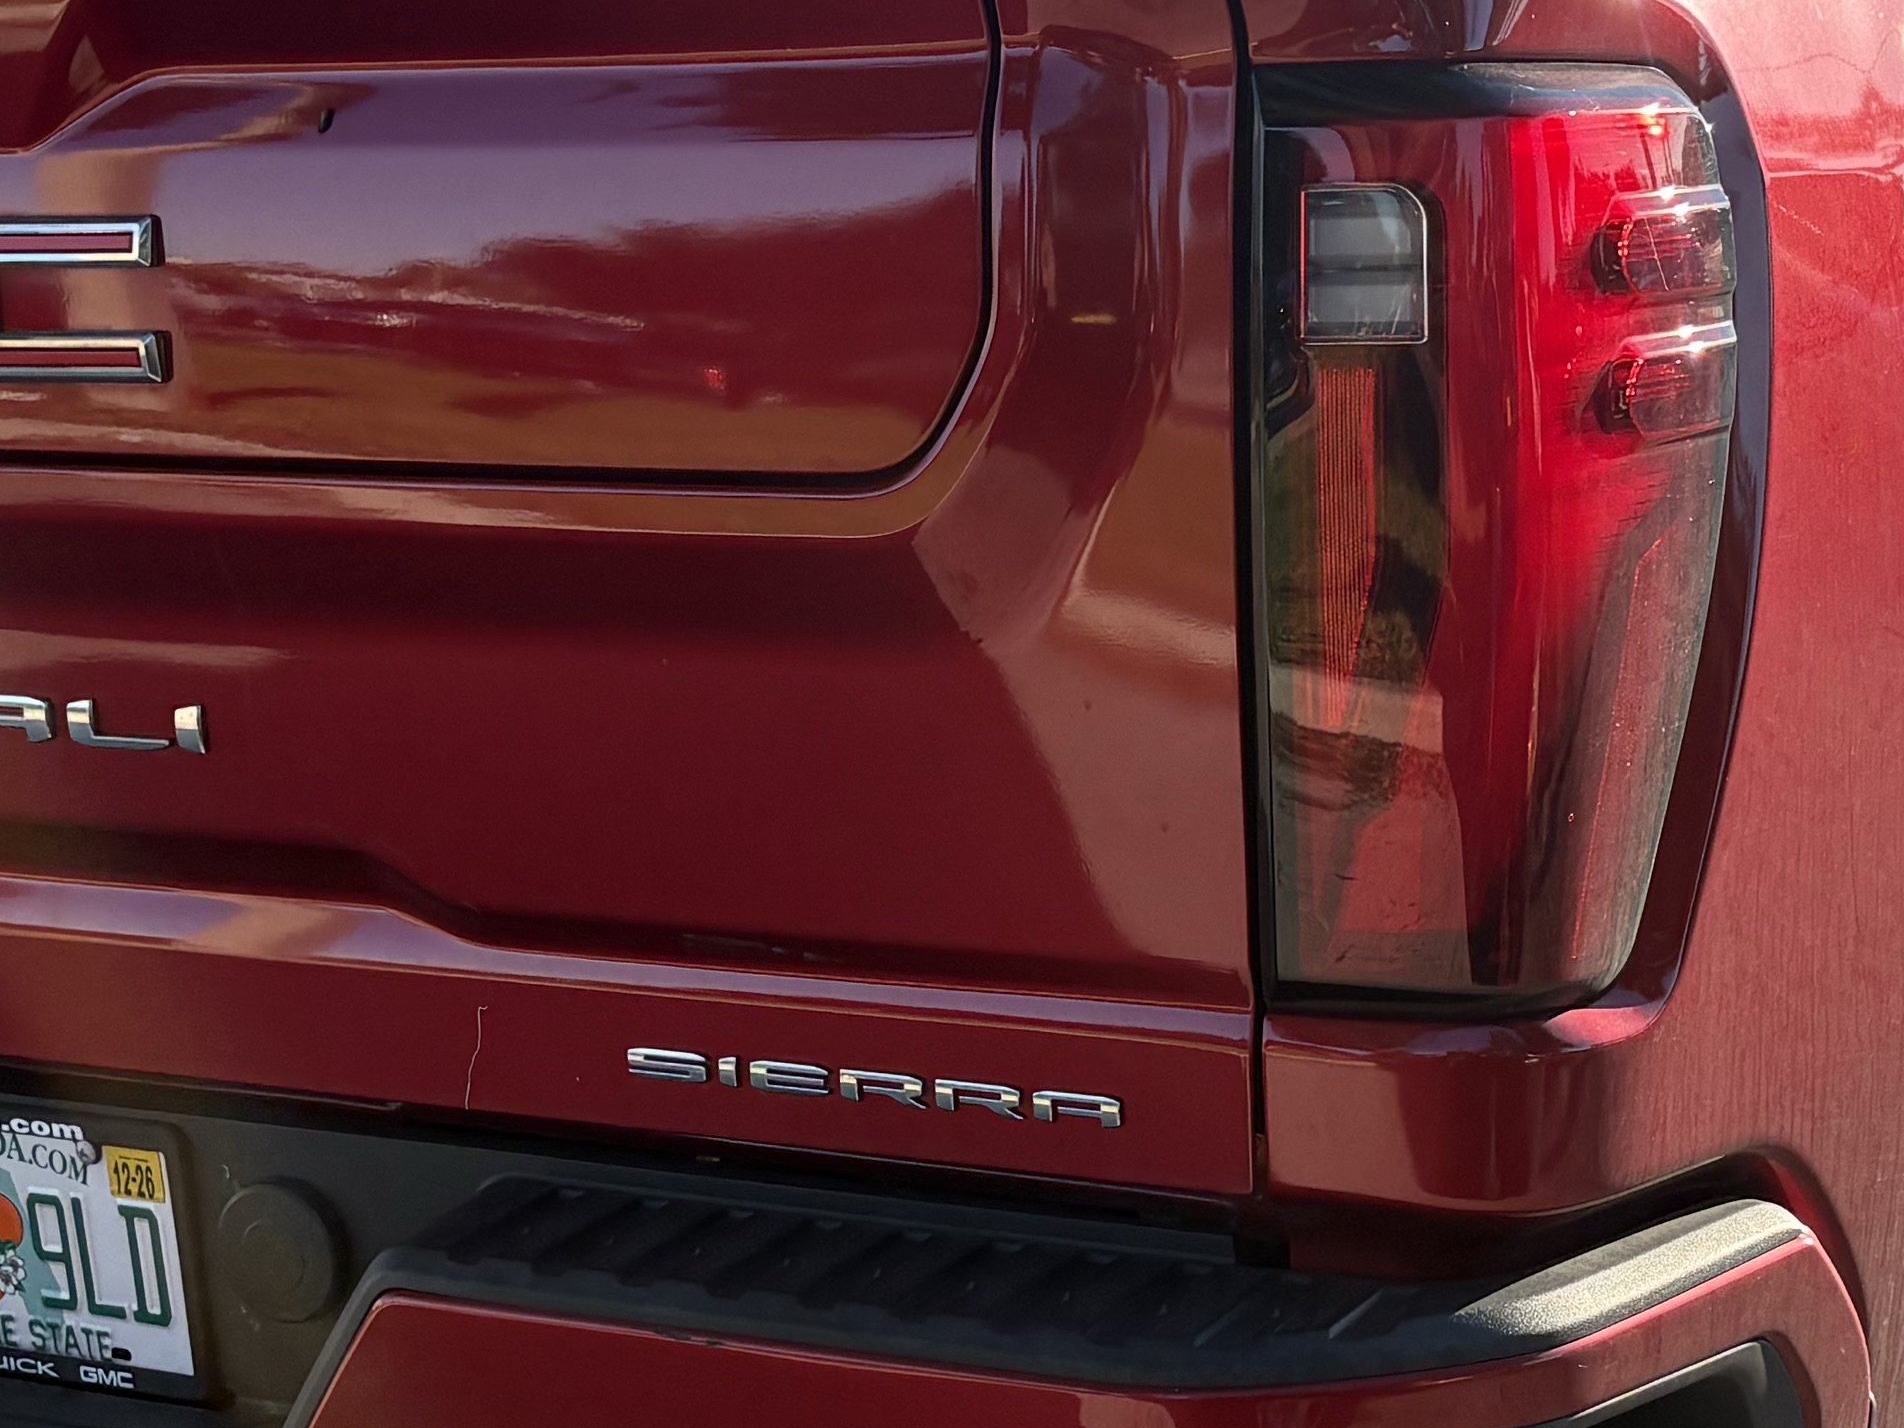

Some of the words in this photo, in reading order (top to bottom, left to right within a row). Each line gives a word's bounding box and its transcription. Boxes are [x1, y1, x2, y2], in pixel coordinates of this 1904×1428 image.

[626, 1046, 1123, 1128] SIERRA
[113, 1159, 155, 1200] 12-26
[27, 1192, 173, 1327] 9LD
[28, 1317, 113, 1361] STATE
[79, 1365, 135, 1389] GMC
